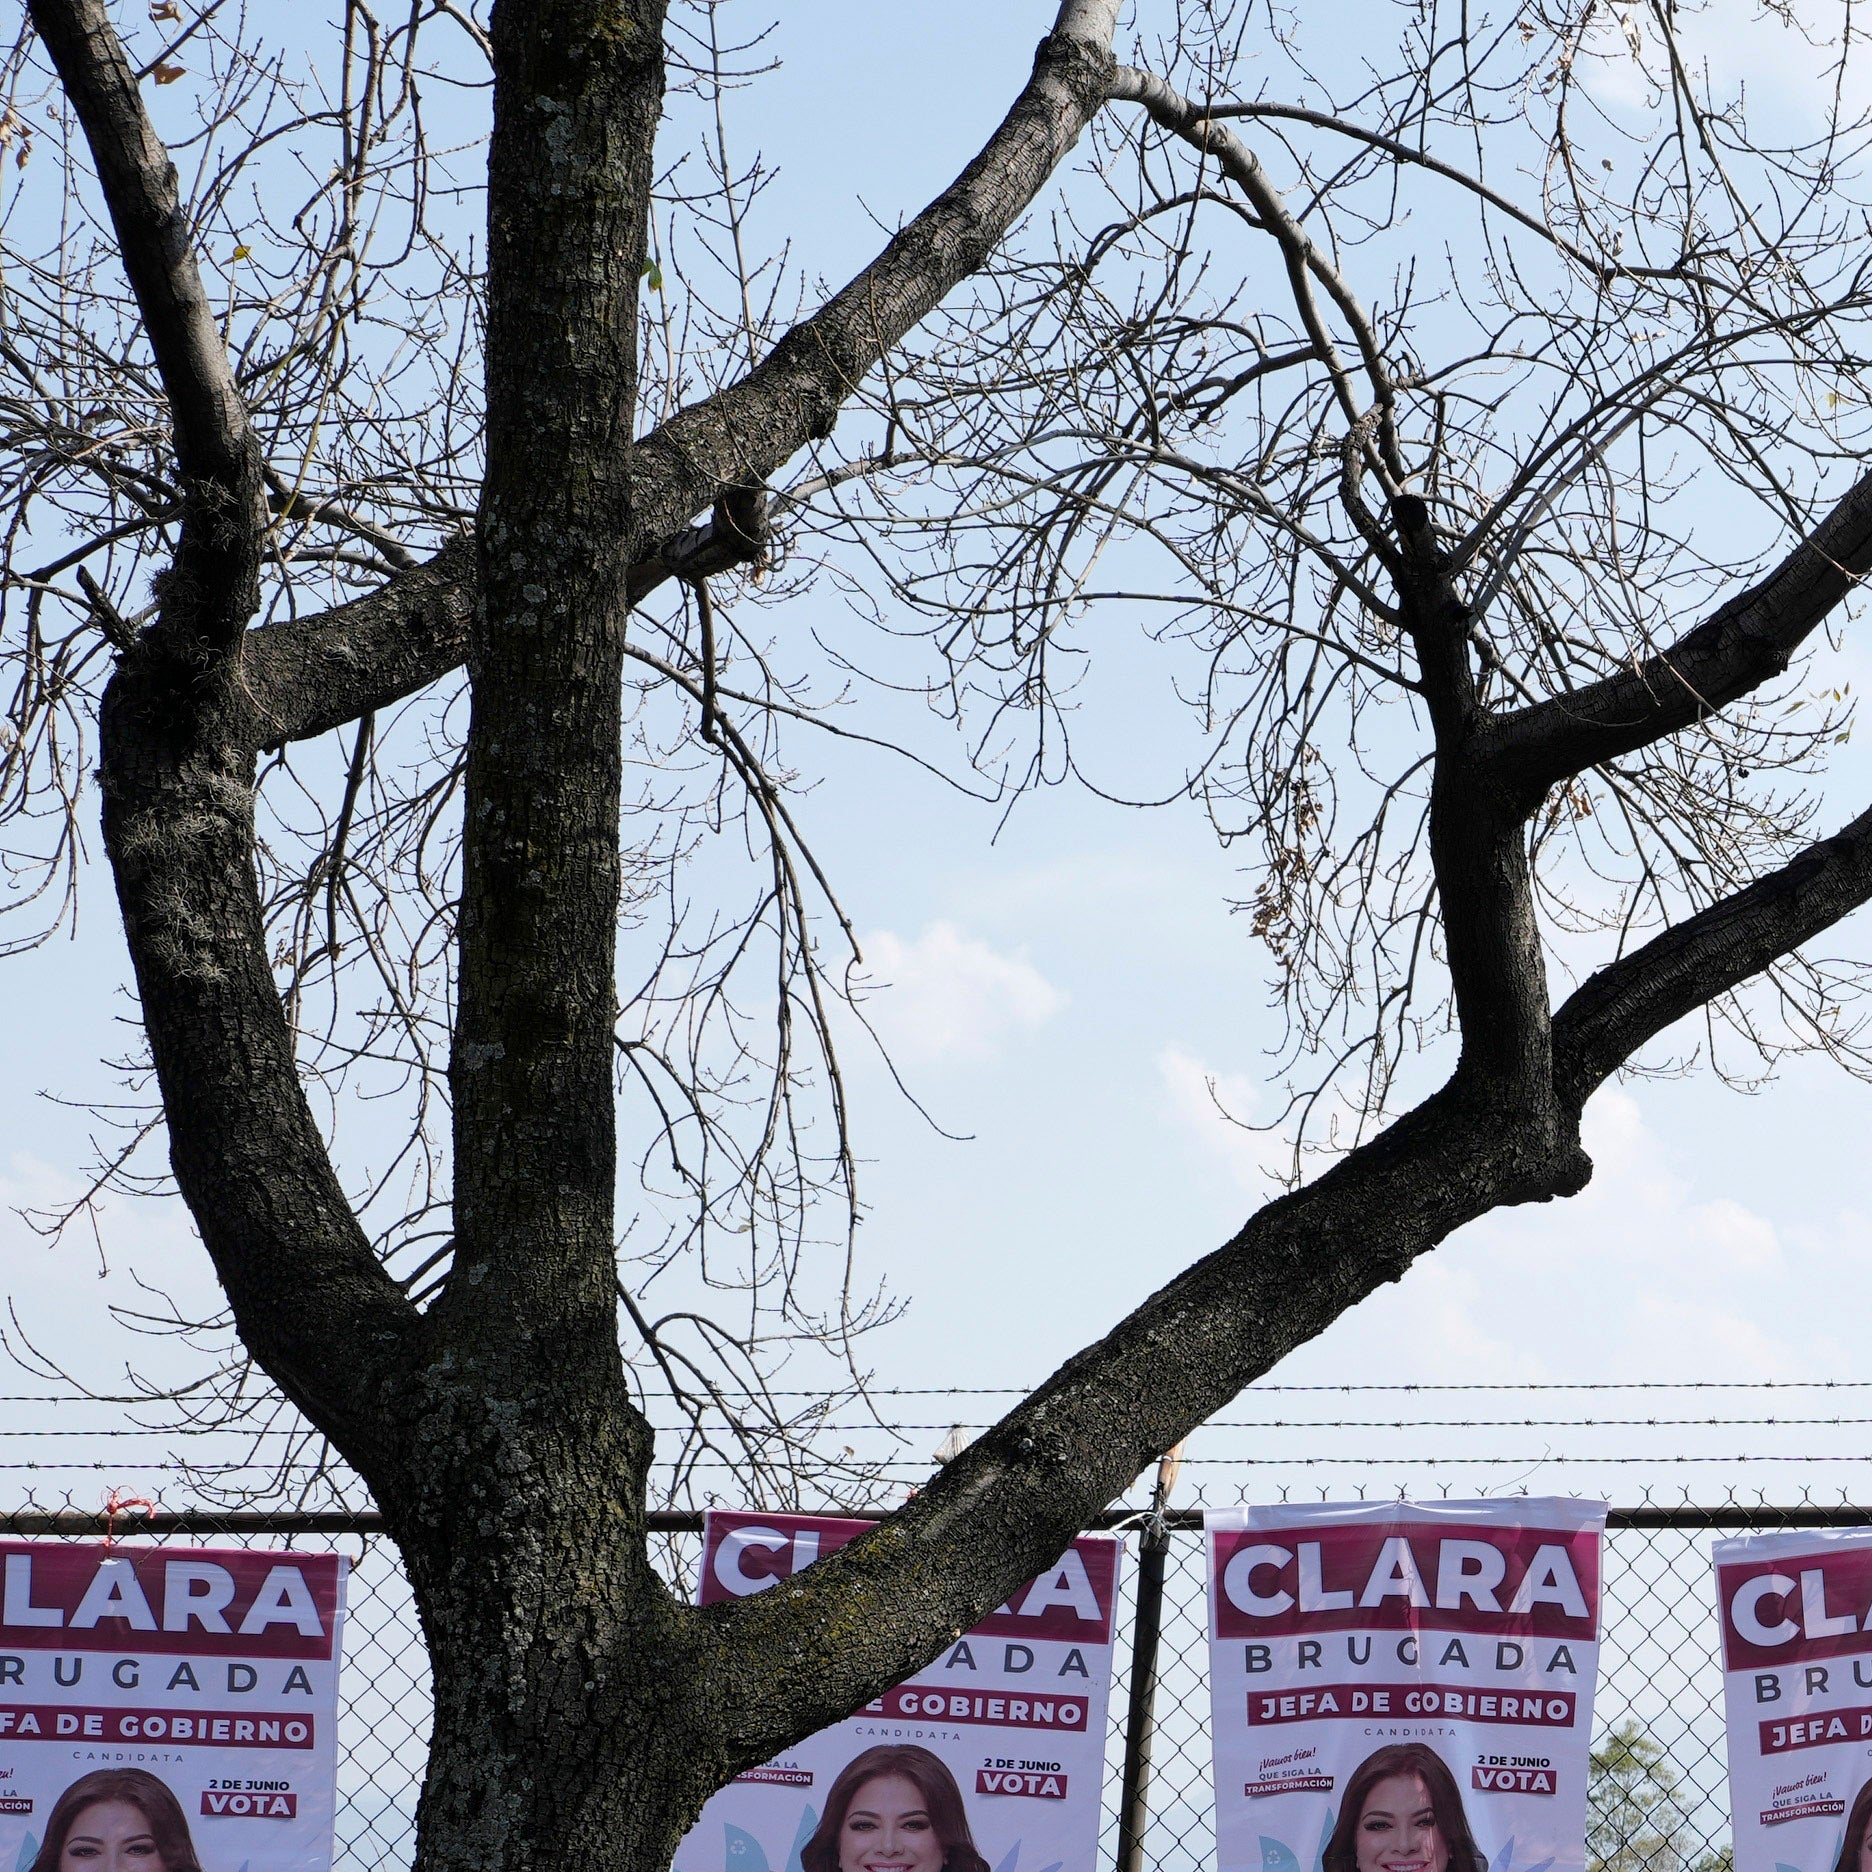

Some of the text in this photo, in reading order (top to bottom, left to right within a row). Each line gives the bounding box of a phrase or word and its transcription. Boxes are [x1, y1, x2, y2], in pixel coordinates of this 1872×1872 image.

[1223, 1536, 1591, 1619] CLARA
[3, 1553, 326, 1637] LARA
[1245, 1637, 1577, 1674] BRUGADA
[0, 1655, 313, 1695] RUGADA
[897, 1691, 1083, 1725] GOBIERNO
[1260, 1691, 1570, 1722] JEFA DE GOBIERNO
[56, 1712, 309, 1743] DE GOBIERNO
[854, 1726, 962, 1741] CANDIDATA
[1771, 1717, 1848, 1748] JEFA
[983, 1758, 1062, 1773] 2 DE JUNIO
[1476, 1769, 1552, 1792] VOTA
[208, 1779, 291, 1792] 2 DE JUNIO
[981, 1772, 1063, 1797] VOTA
[207, 1793, 292, 1816] VOTA
